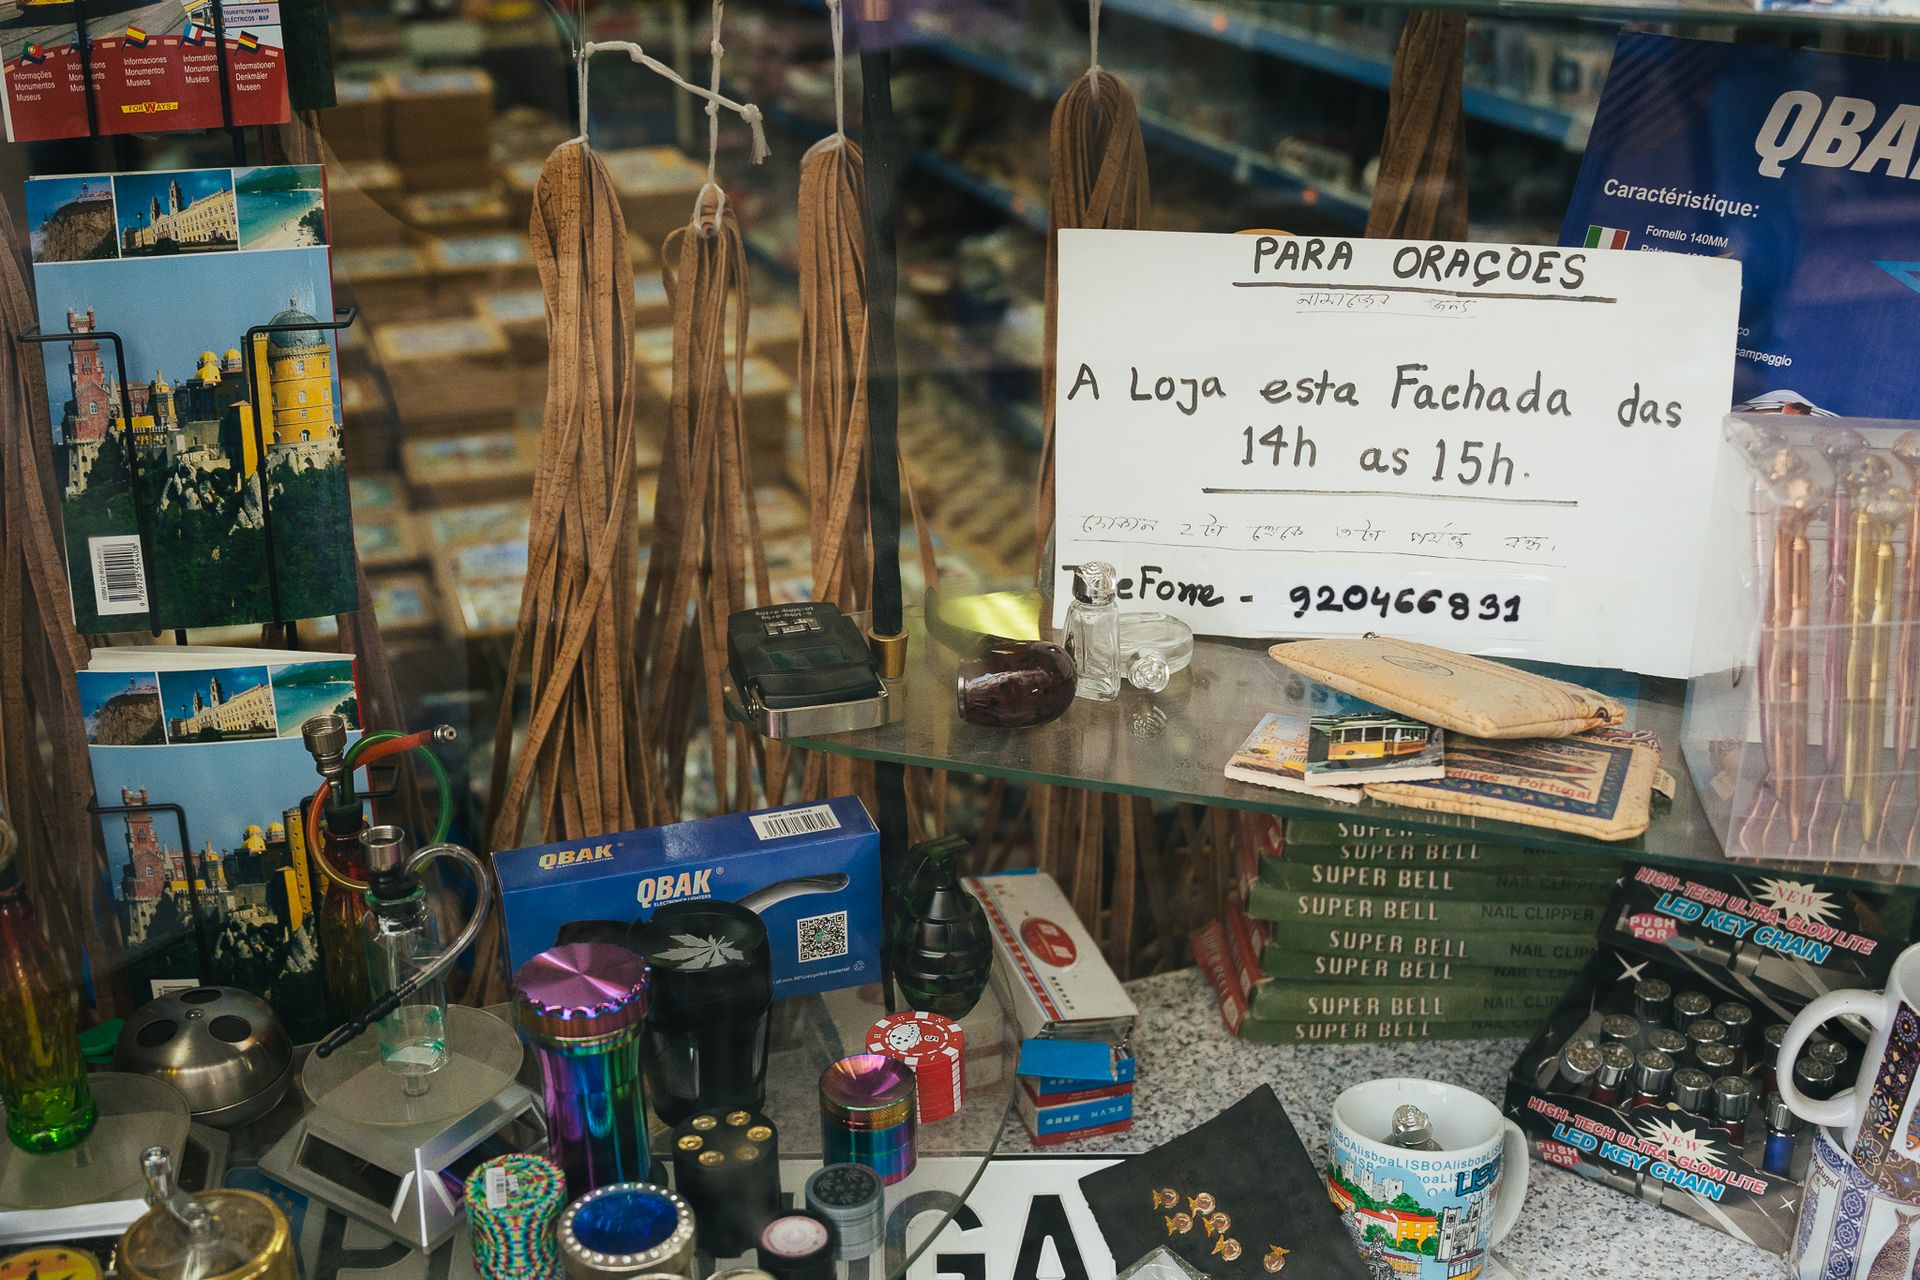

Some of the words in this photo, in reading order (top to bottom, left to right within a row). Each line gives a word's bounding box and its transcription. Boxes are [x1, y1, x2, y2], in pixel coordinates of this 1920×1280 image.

[123, 56, 167, 66] Informaciones
[234, 61, 276, 71] Informationen
[13, 71, 53, 81] Informações
[125, 67, 165, 76] Monumentos
[185, 75, 210, 84] Musées
[235, 72, 268, 82] Denkmäler
[15, 81, 56, 91] Monumentos
[126, 79, 151, 87] Museos
[236, 83, 261, 92] Museen
[16, 93, 41, 102] Museus
[1754, 90, 1920, 180] QBA
[1603, 178, 1759, 218] Caractéristique:
[1645, 225, 1687, 241] Fornello
[1690, 232, 1729, 248] 140MM
[1254, 236, 1353, 274] PARA
[1068, 363, 1100, 400] A
[1130, 366, 1227, 415] Loja
[1260, 369, 1360, 406] esta
[1390, 362, 1572, 417] Fachada
[1617, 382, 1683, 428] das
[1241, 425, 1317, 467] 14h
[1359, 447, 1410, 476] as
[1289, 584, 1522, 623] 920466831
[1517, 777, 1593, 801] Portugal
[538, 844, 613, 870] QBAK
[1340, 843, 1414, 860] SUPER
[1426, 843, 1481, 860] BELL
[1312, 864, 1386, 887] SUPER
[1398, 869, 1454, 891] BELL
[1497, 875, 1533, 889] NAIL
[636, 868, 713, 909] QBAK
[1772, 885, 1816, 908] NEW
[1298, 895, 1372, 919] SUPER
[1383, 899, 1439, 922] BELL
[1481, 904, 1518, 919] NAIL
[1524, 906, 1594, 921] CLIPPER
[1635, 866, 1728, 906] HIGH-TECH
[1729, 896, 1838, 943] ULTRA-GLOW
[1836, 931, 1878, 956] LITE
[1629, 916, 1676, 929] PUSH
[1654, 893, 1703, 922] LED
[1702, 906, 1755, 938] KEY
[1754, 925, 1831, 965] CHAIN
[1634, 928, 1668, 940] FOR
[1329, 931, 1403, 954] SUPER
[1414, 935, 1470, 959] BELL
[1510, 943, 1548, 957] NAIL
[1315, 956, 1388, 977] SUPER
[1400, 960, 1454, 980] BELL
[1494, 967, 1530, 978] NAIL
[1308, 997, 1380, 1016] SUPER
[1391, 997, 1445, 1016] BELL
[1483, 997, 1520, 1009] NAIL
[1295, 1022, 1368, 1040] SUPER
[1379, 1020, 1432, 1038] BELL
[1472, 1020, 1505, 1030] NAIL
[1527, 1096, 1616, 1141] HIGH-TECH
[1617, 1129, 1727, 1180] ULTRA-GLOW
[1726, 1171, 1768, 1195] LITE
[1536, 1141, 1578, 1157] PUSH
[1659, 1131, 1702, 1153] NEW
[1543, 1152, 1574, 1166] FOR
[1552, 1124, 1598, 1151] LED
[1599, 1141, 1650, 1171] KEY
[1649, 1163, 1726, 1201] CHAIN
